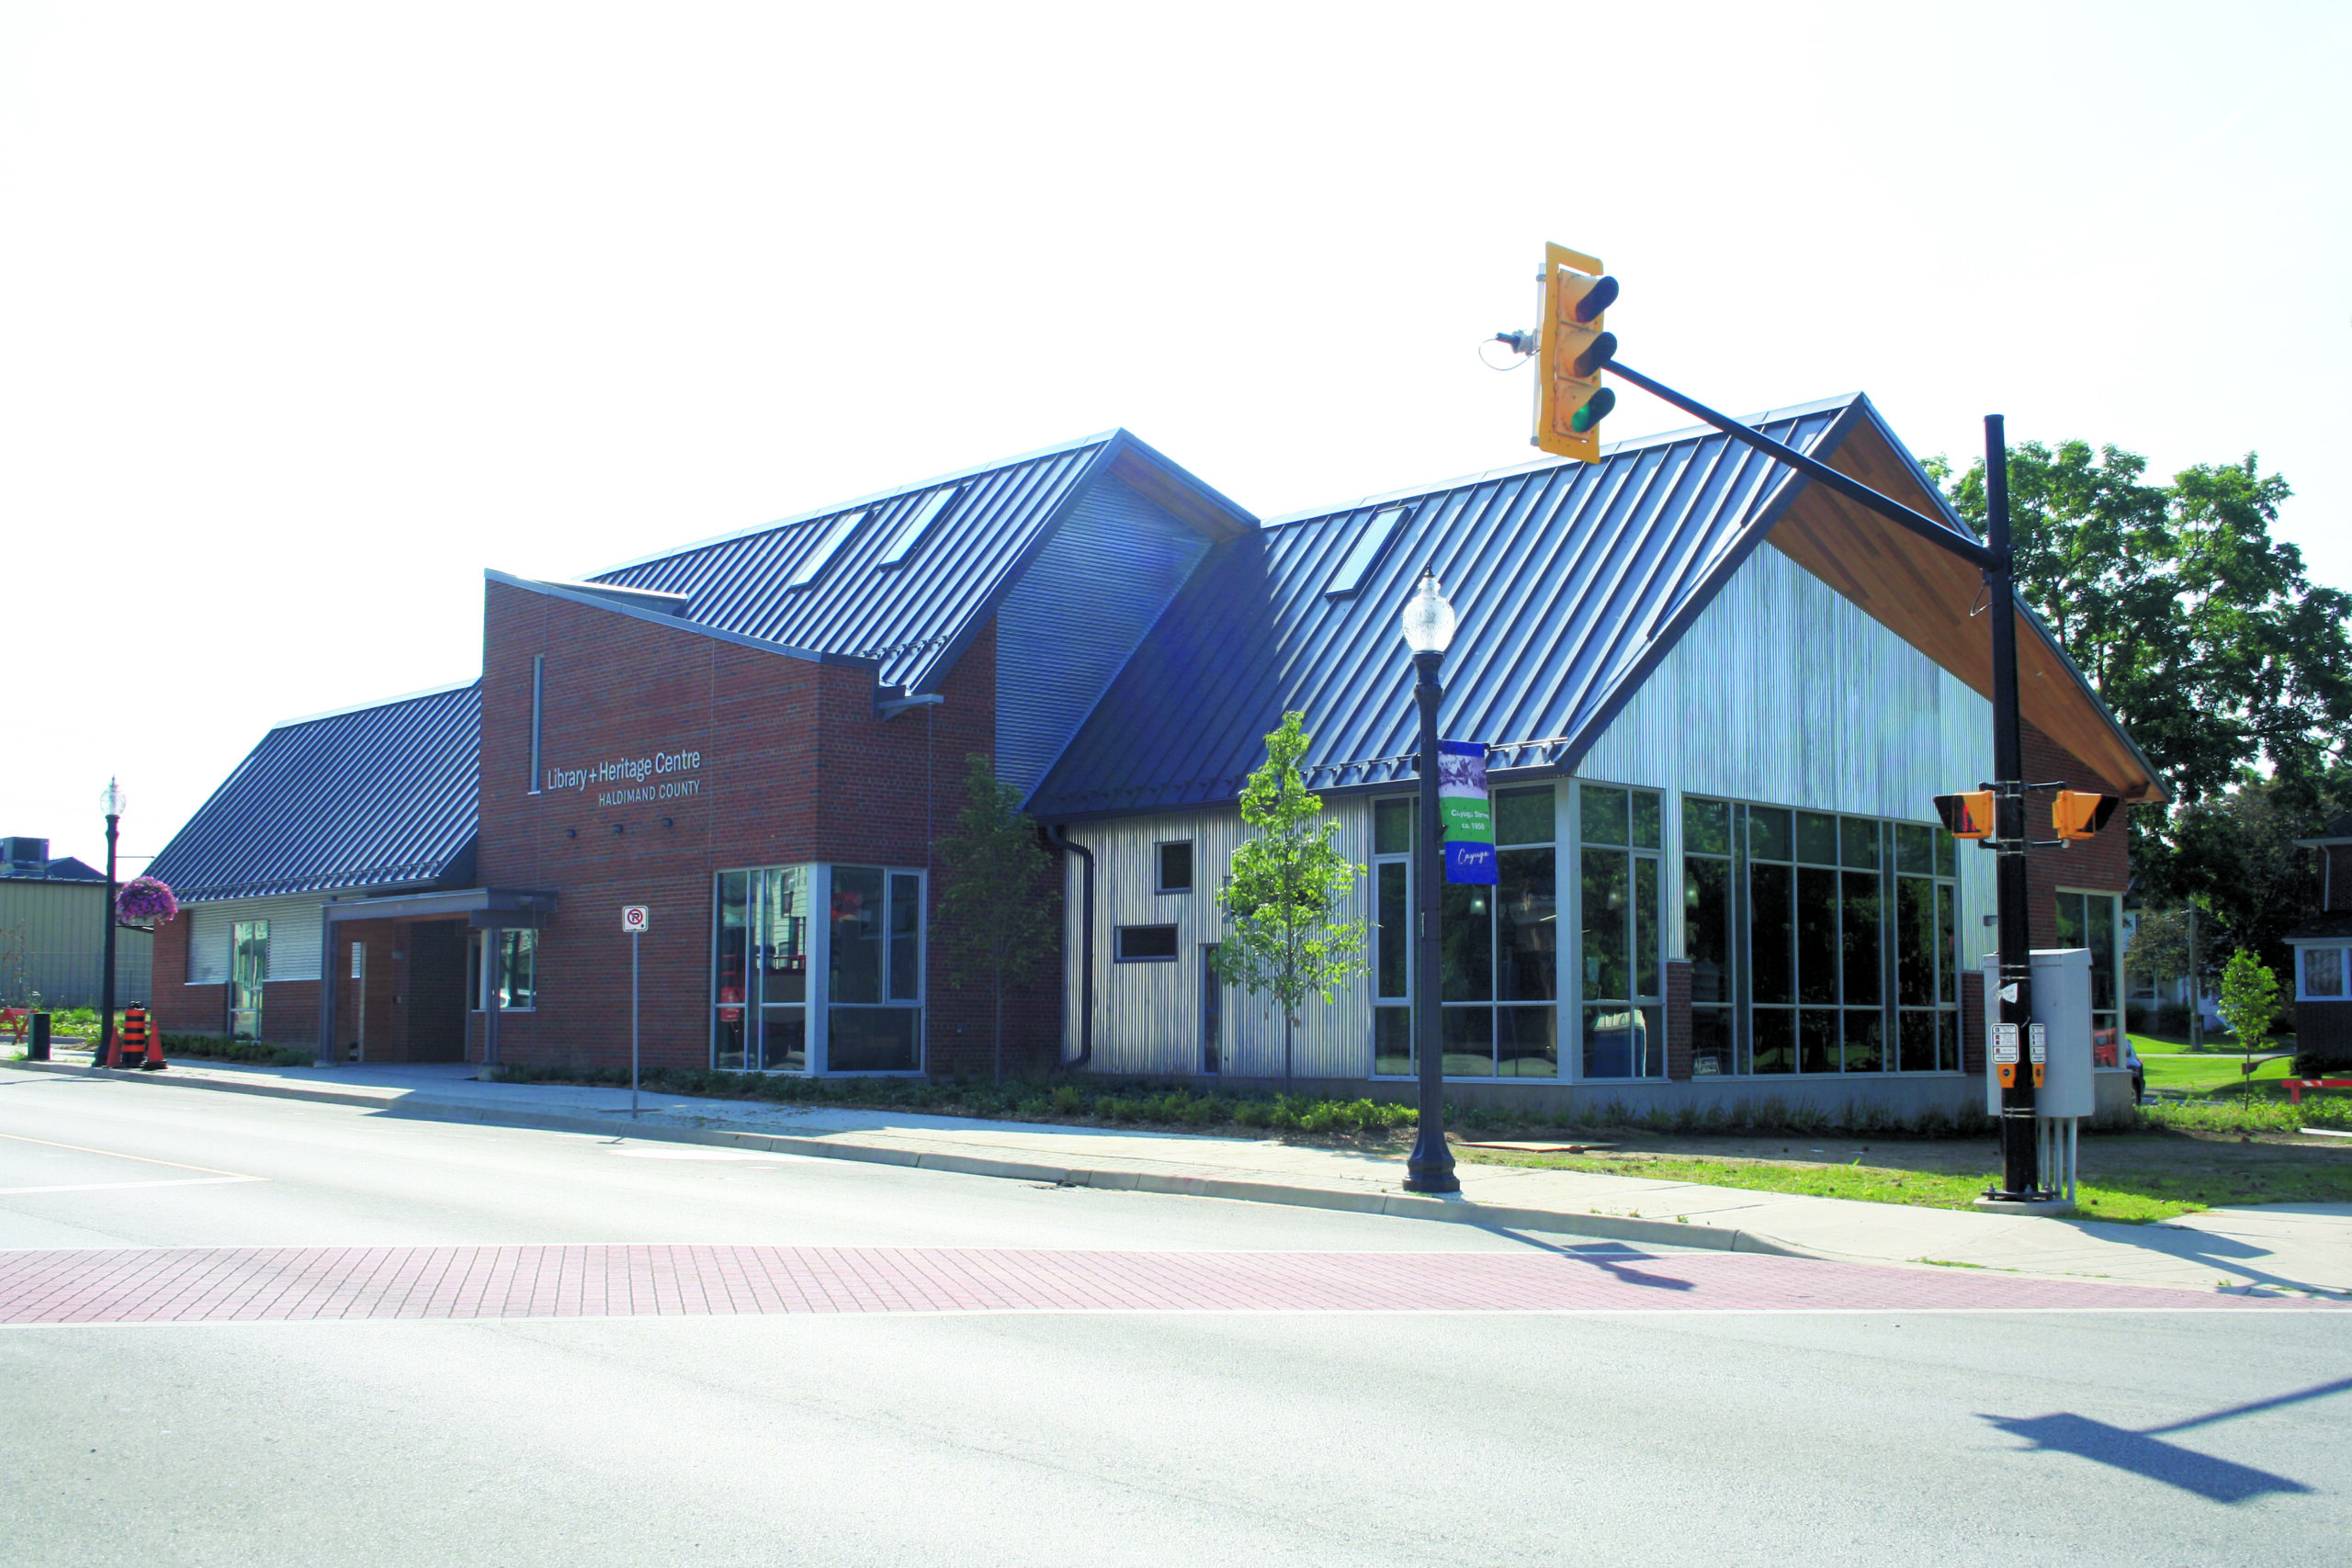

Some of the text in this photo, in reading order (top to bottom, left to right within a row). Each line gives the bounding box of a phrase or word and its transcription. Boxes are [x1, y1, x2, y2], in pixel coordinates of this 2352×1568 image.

[548, 767, 587, 791] Library
[599, 758, 652, 783] Heritage
[655, 750, 700, 774] Centre
[600, 780, 700, 807] HALDIMAND COUNTY
[1457, 848, 1489, 864] Cayuga
